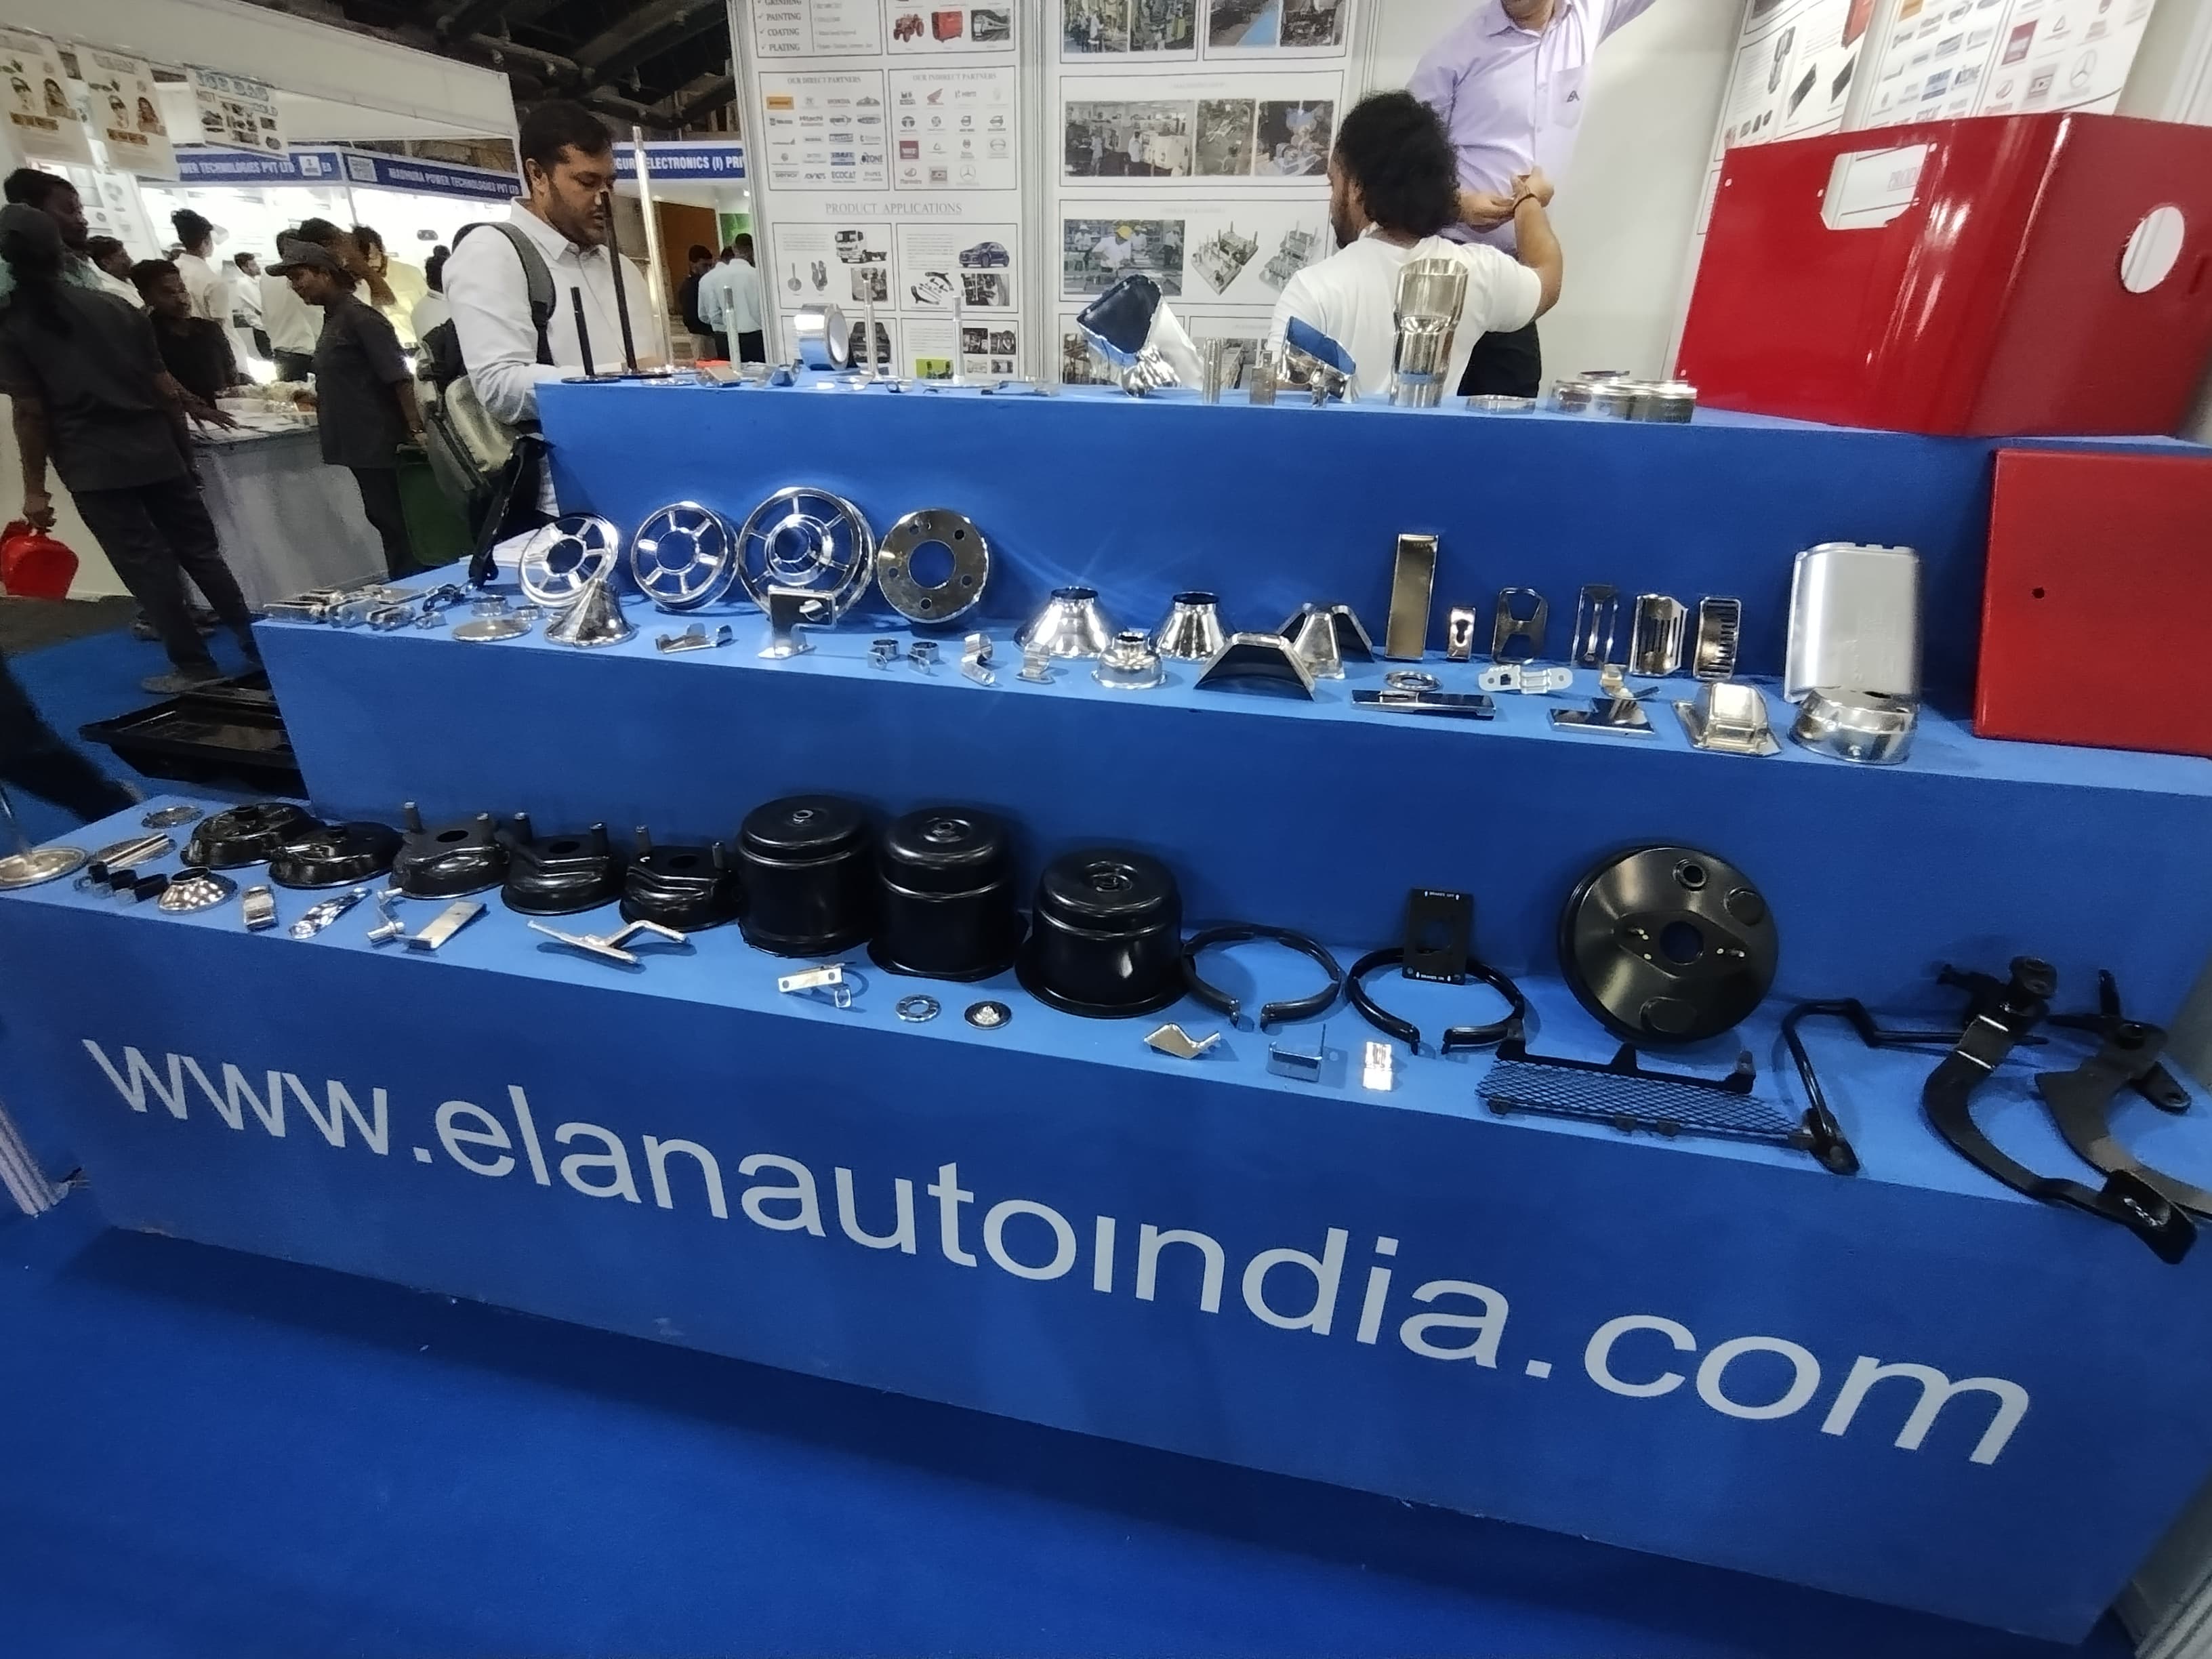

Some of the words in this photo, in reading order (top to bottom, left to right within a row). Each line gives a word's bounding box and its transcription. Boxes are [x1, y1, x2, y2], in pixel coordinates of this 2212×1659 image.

[766, 13, 802, 21] PAINTING
[767, 28, 800, 37] COATING
[769, 43, 800, 52] PLATING
[802, 77, 826, 85] DIRECT
[827, 75, 862, 83] PARTNERS
[261, 161, 279, 173] PVT
[279, 161, 295, 173] LTD
[645, 157, 710, 169] ELECTRONICS
[725, 155, 745, 169] PRI
[825, 203, 878, 213] PRODUCT
[883, 203, 962, 213] APPLICATIONS
[81, 1038, 2029, 1465] www.elanautoindia.com
